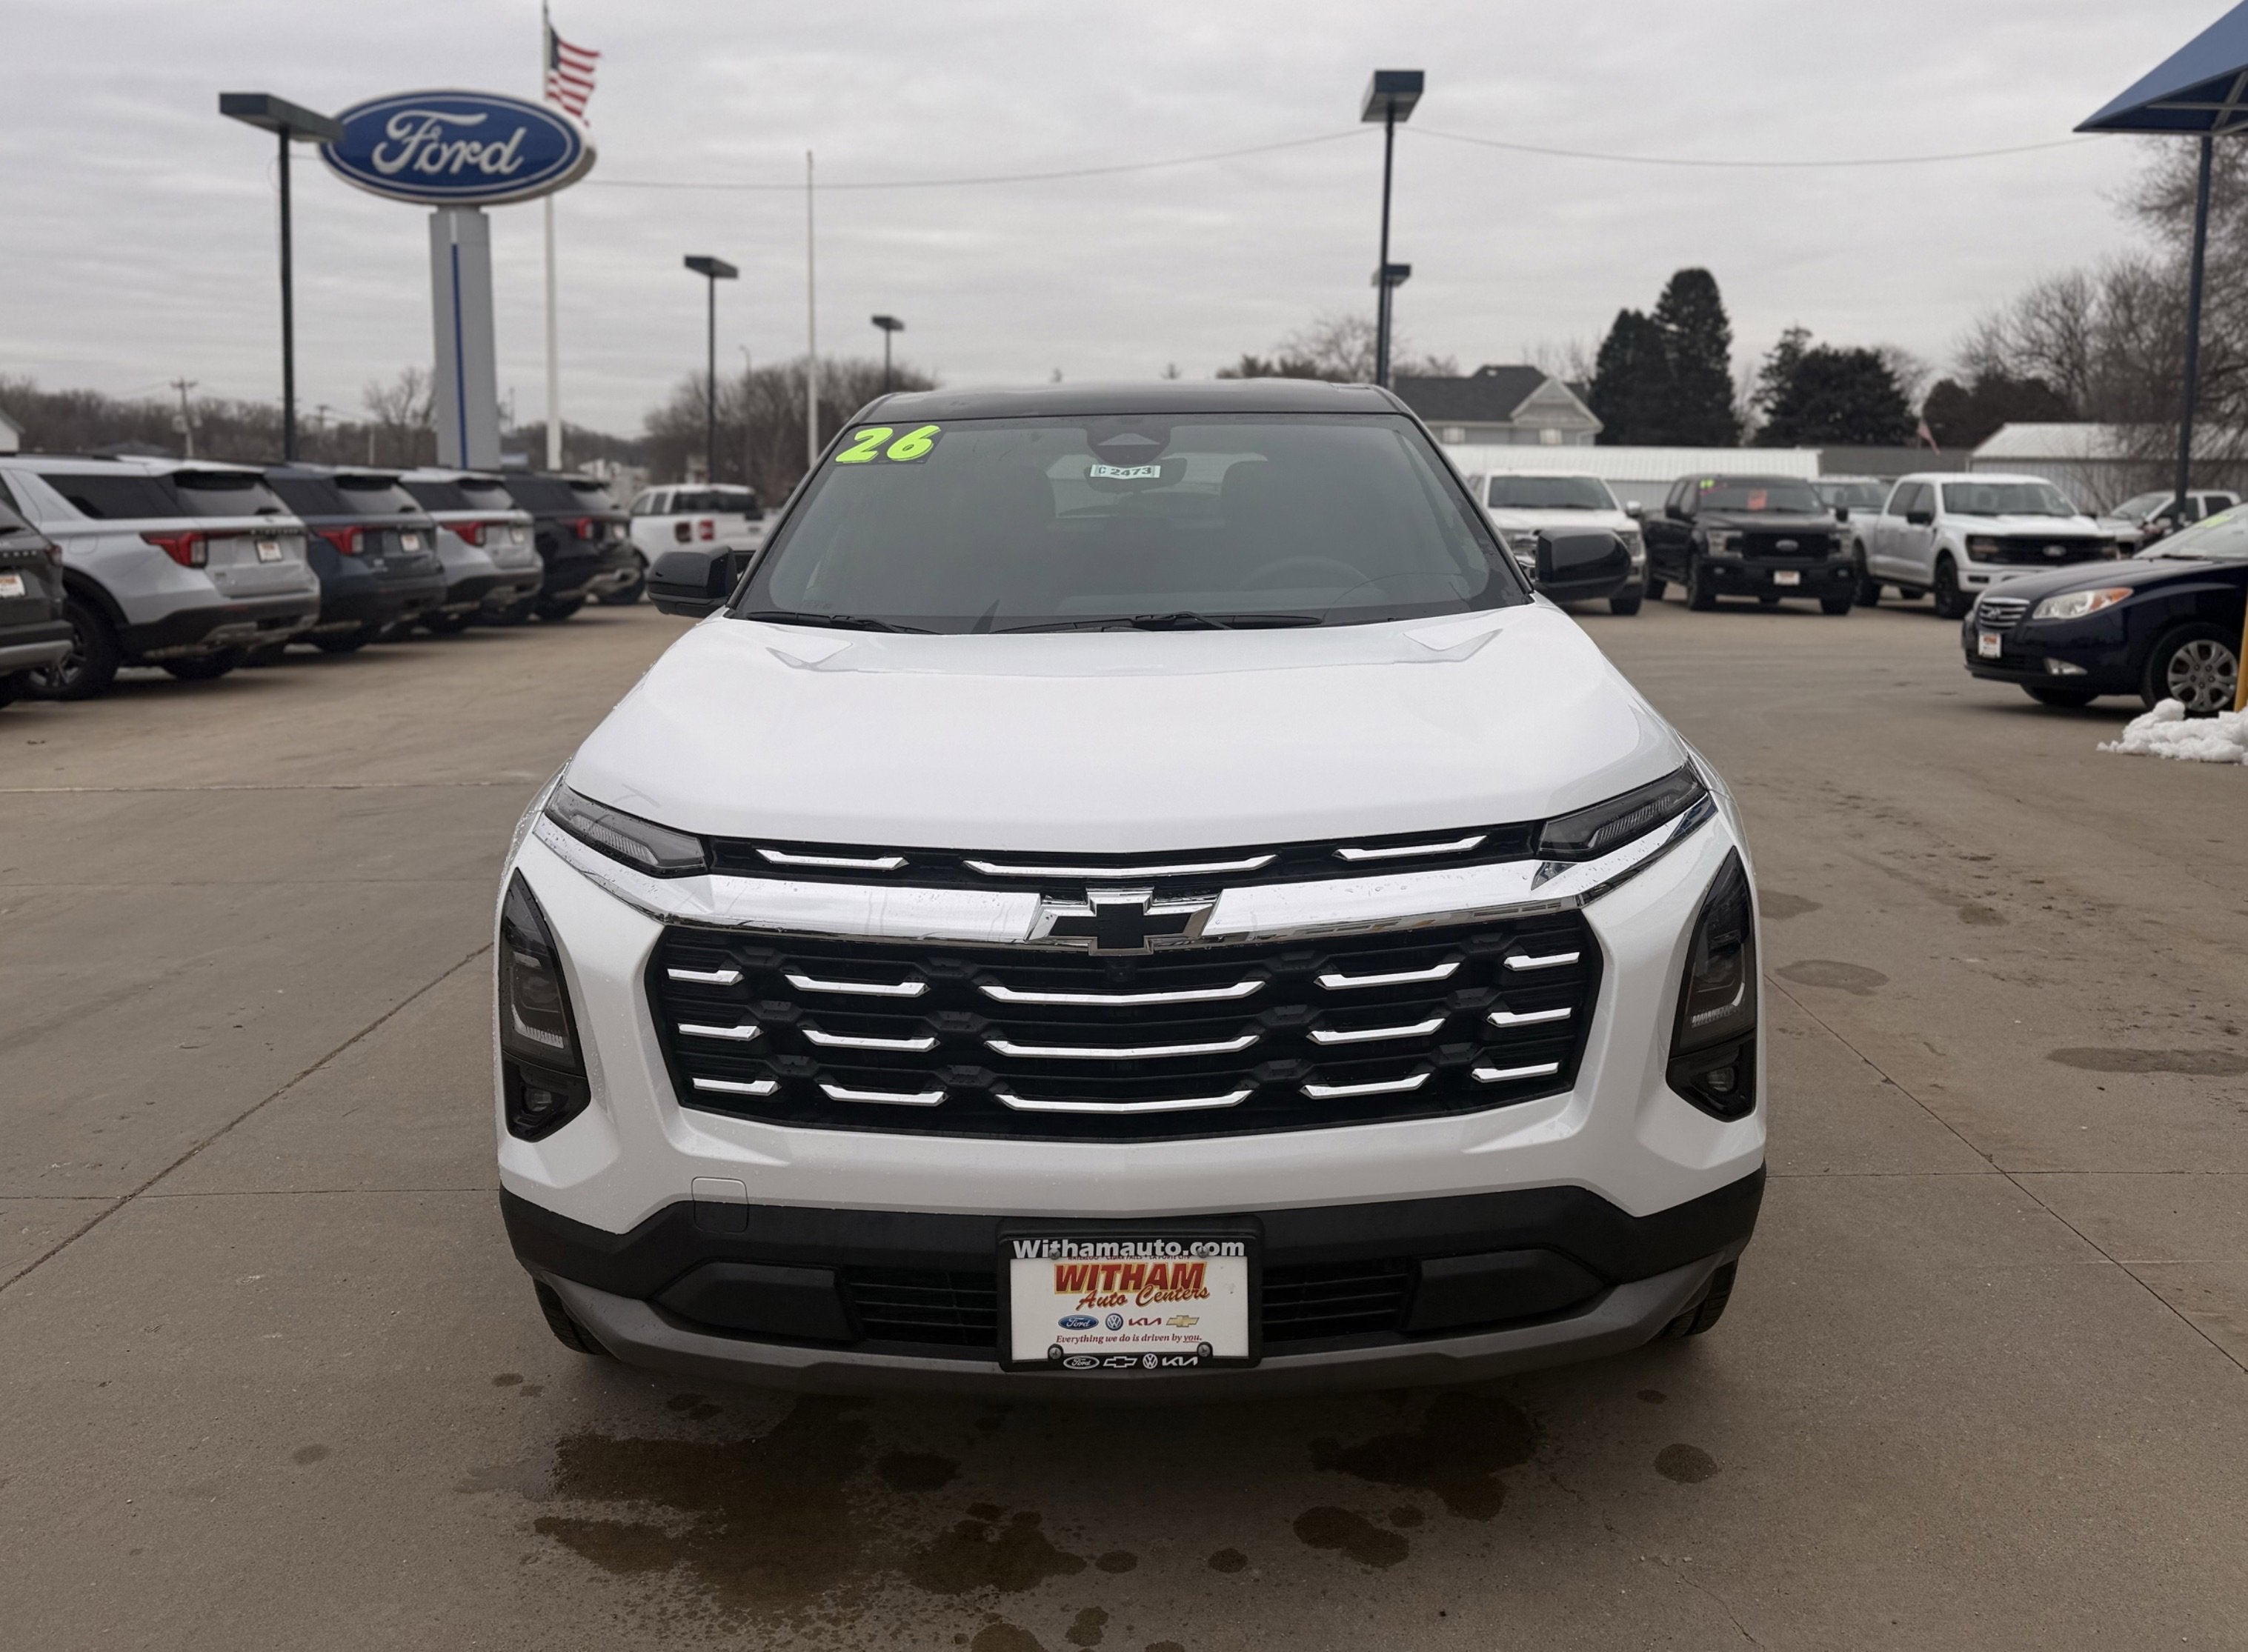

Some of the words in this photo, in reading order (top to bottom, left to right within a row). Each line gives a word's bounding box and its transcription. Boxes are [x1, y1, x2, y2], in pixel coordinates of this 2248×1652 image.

[372, 110, 527, 175] Ford
[835, 425, 942, 464] 26
[1110, 467, 1151, 476] 2473
[1013, 1239, 1245, 1259] Withamauto.com
[1054, 1262, 1207, 1294] WITHAM
[1075, 1289, 1128, 1311] Auto
[1135, 1284, 1211, 1308] Centers
[1056, 1334, 1104, 1345] Everything
[1119, 1333, 1131, 1342] do
[1132, 1333, 1140, 1342] is
[1141, 1333, 1169, 1342] driven
[1171, 1333, 1183, 1342] by
